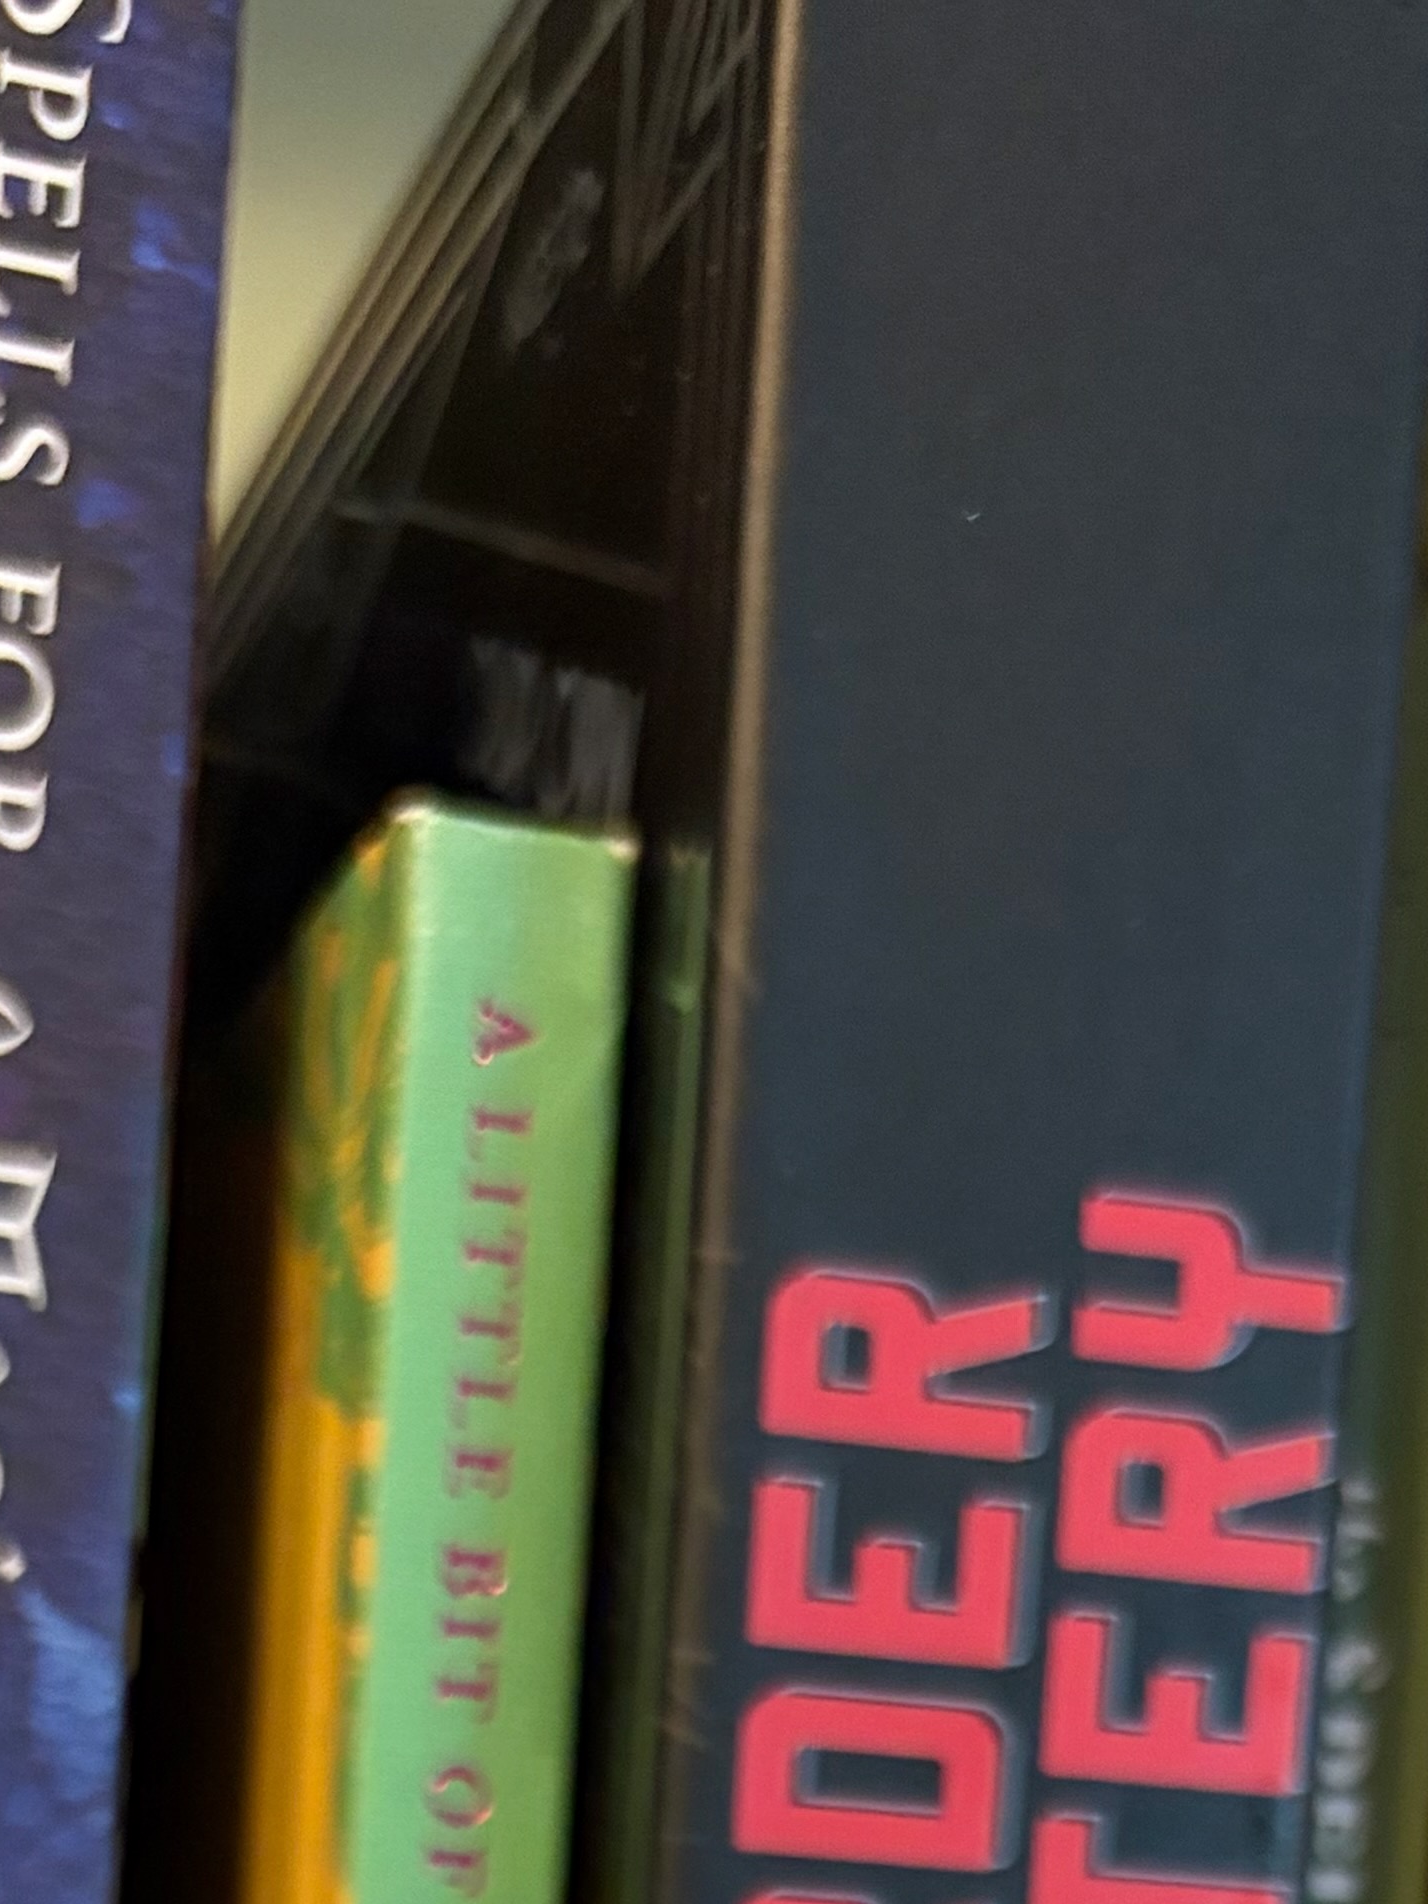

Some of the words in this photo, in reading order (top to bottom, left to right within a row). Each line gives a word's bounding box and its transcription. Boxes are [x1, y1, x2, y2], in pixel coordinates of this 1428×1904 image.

[471, 995, 537, 1067] A
[447, 1109, 534, 1500] LITTLE
[436, 1545, 508, 1724] BIT
[424, 1765, 494, 1898] OF
